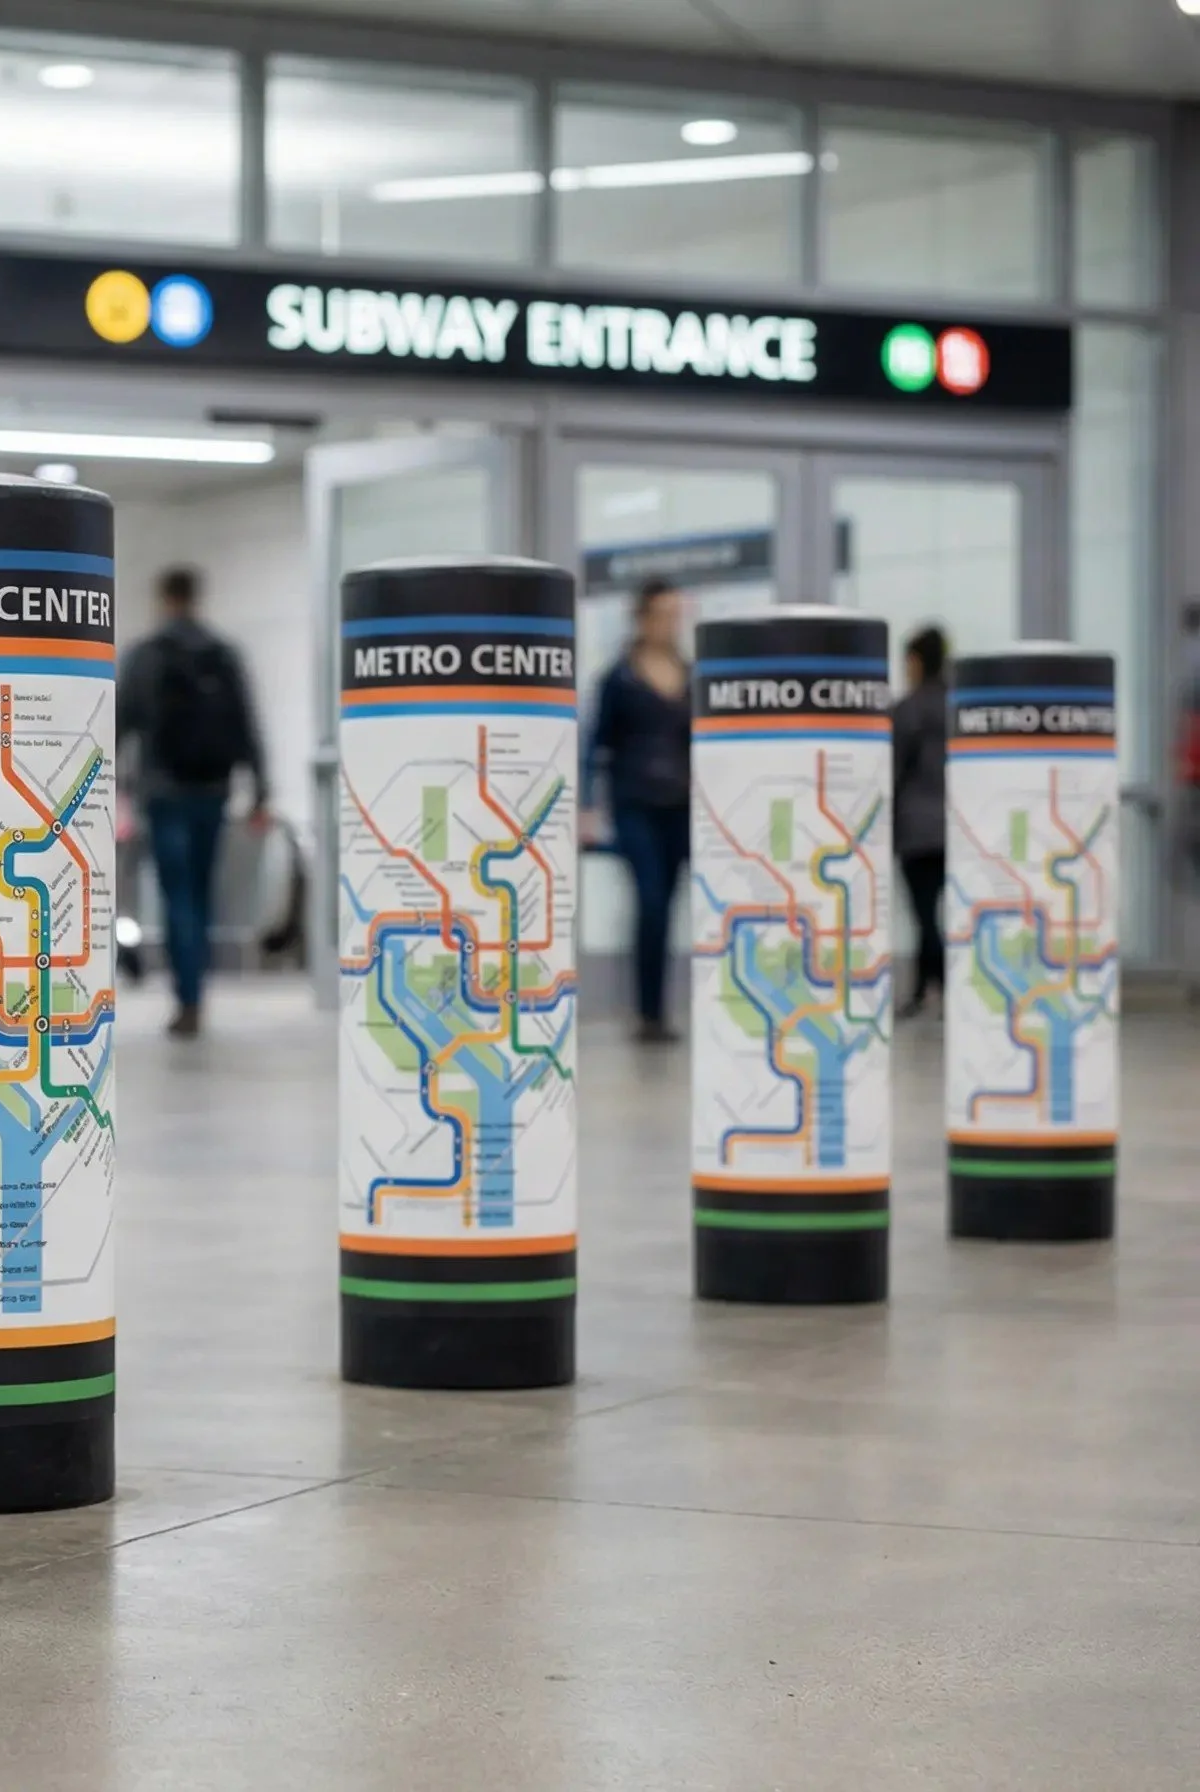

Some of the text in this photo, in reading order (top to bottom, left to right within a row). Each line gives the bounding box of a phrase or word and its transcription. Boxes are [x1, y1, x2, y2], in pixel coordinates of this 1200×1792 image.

[266, 283, 518, 363] SUBWAY
[526, 300, 817, 382] ENTRANCE
[354, 644, 574, 678] METRO CENTER
[709, 679, 804, 709] METRO
[958, 705, 1040, 734] METRO
